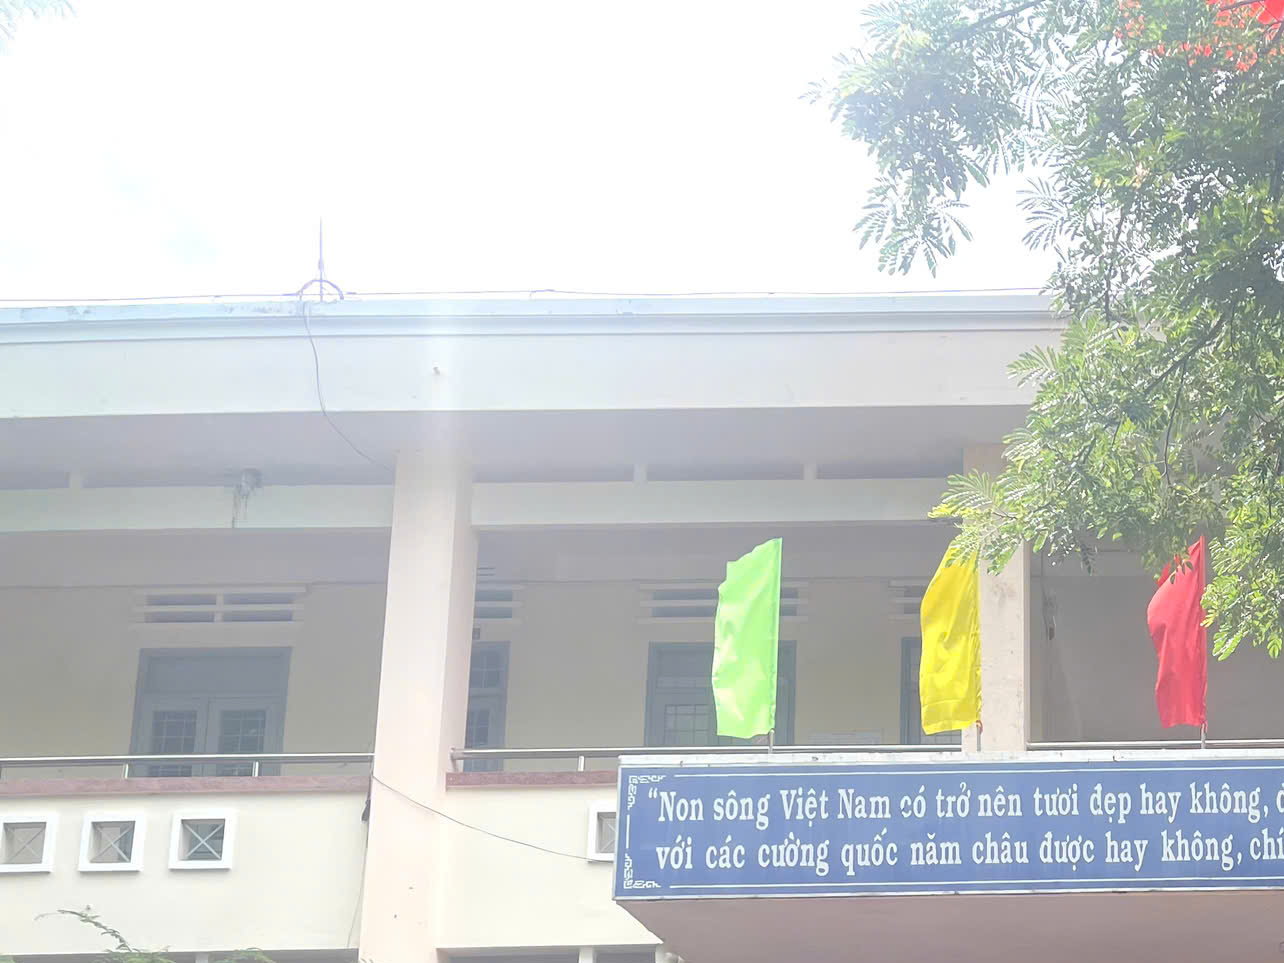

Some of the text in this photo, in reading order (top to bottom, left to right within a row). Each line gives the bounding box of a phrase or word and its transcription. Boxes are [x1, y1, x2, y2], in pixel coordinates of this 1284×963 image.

[712, 788, 772, 832] sông
[778, 786, 830, 828] Việt
[836, 787, 892, 820] Nam
[899, 784, 927, 819] có
[935, 781, 972, 819] trở
[976, 784, 1023, 817] nên
[1032, 782, 1080, 817] tươi
[1089, 782, 1132, 825] đẹp
[1139, 782, 1182, 824] hay
[1189, 781, 1269, 824] không,
[655, 833, 694, 871] với
[705, 833, 746, 870] các
[757, 831, 830, 877] cường
[840, 826, 898, 877] quốc
[909, 832, 963, 866] năm
[971, 831, 1030, 865] châu
[1038, 830, 1095, 872] được
[1104, 830, 1149, 873] hay
[1160, 828, 1243, 872] không,
